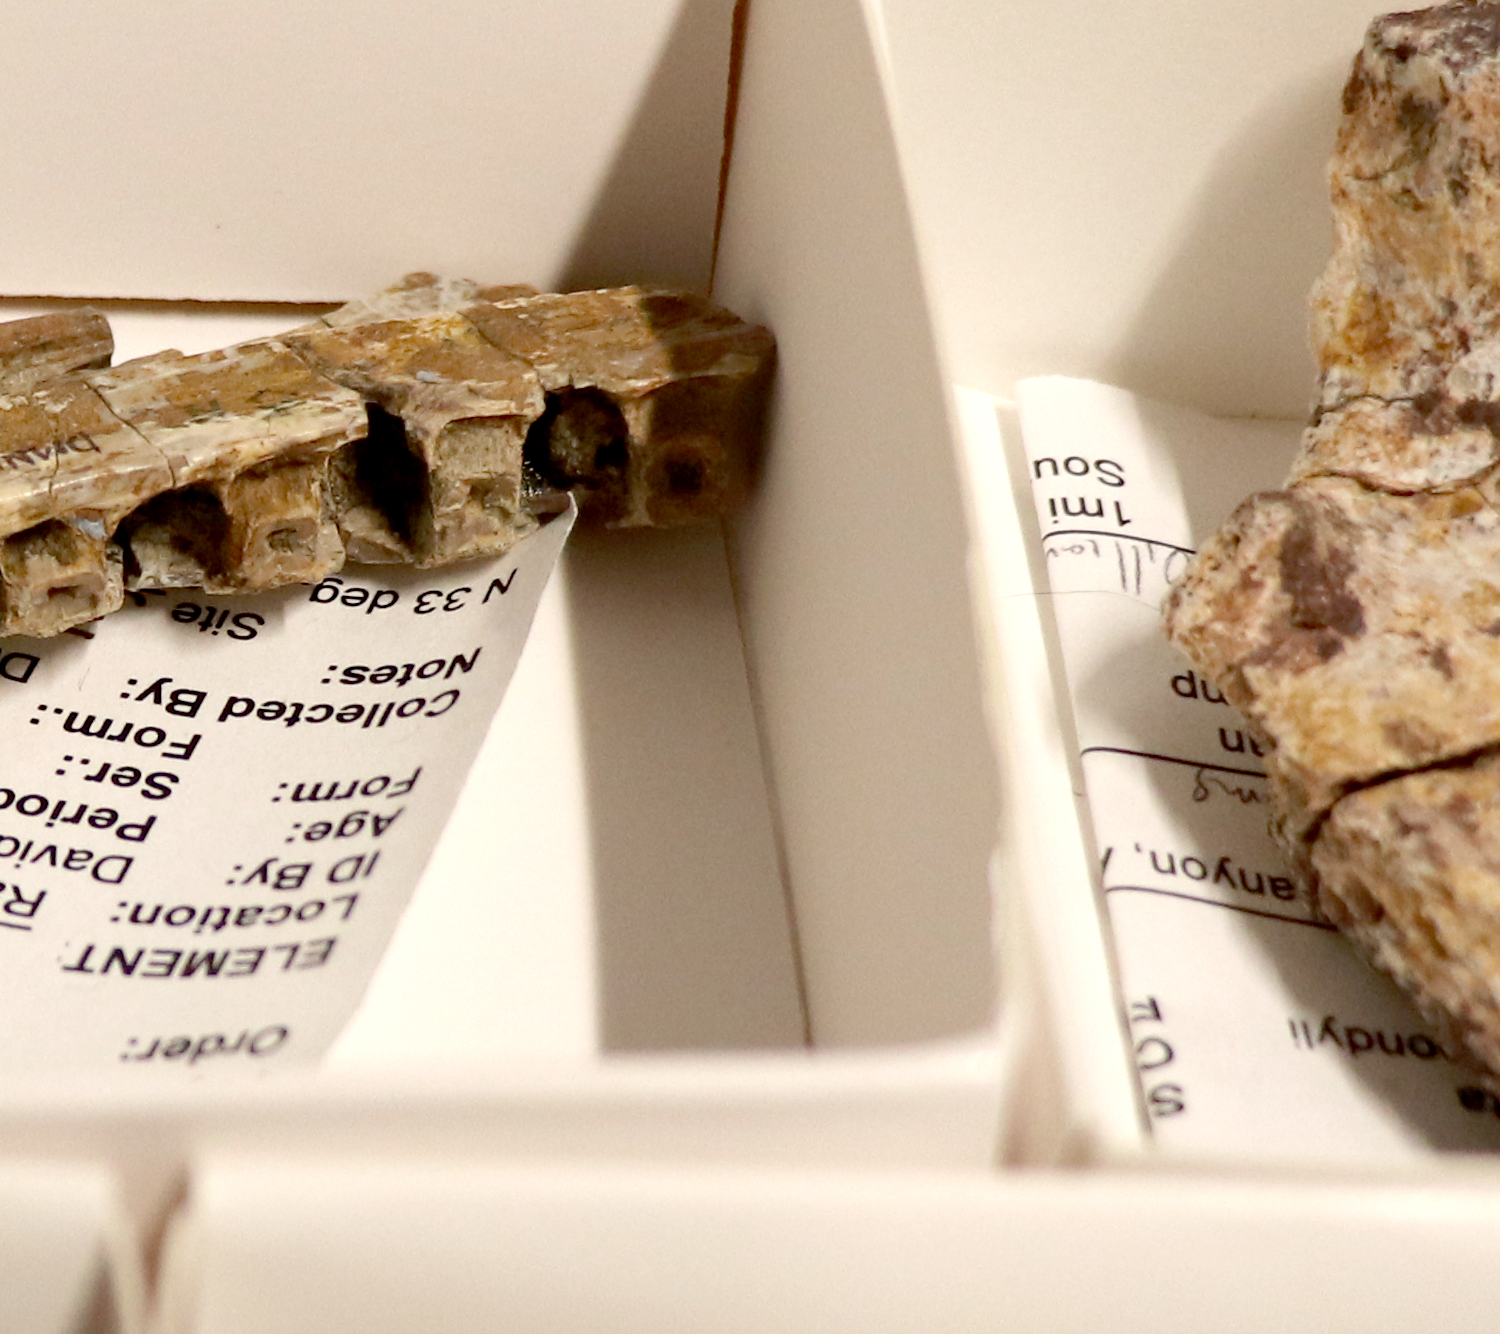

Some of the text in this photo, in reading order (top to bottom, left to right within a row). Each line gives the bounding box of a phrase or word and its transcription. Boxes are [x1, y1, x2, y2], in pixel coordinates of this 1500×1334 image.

[309, 567, 520, 616] N 33 deg
[171, 601, 485, 687] Notes: Site
[119, 676, 209, 720] By:
[217, 687, 462, 731] Collected
[28, 702, 203, 763] Form.:
[54, 752, 182, 802] Ser.:
[271, 765, 423, 805] Form:
[285, 806, 406, 844] Age:
[225, 856, 314, 891] By:
[326, 849, 381, 886] ID
[109, 892, 360, 934] Location:
[118, 1023, 290, 1067] Order:
[1288, 1014, 1450, 1062] ondyli
